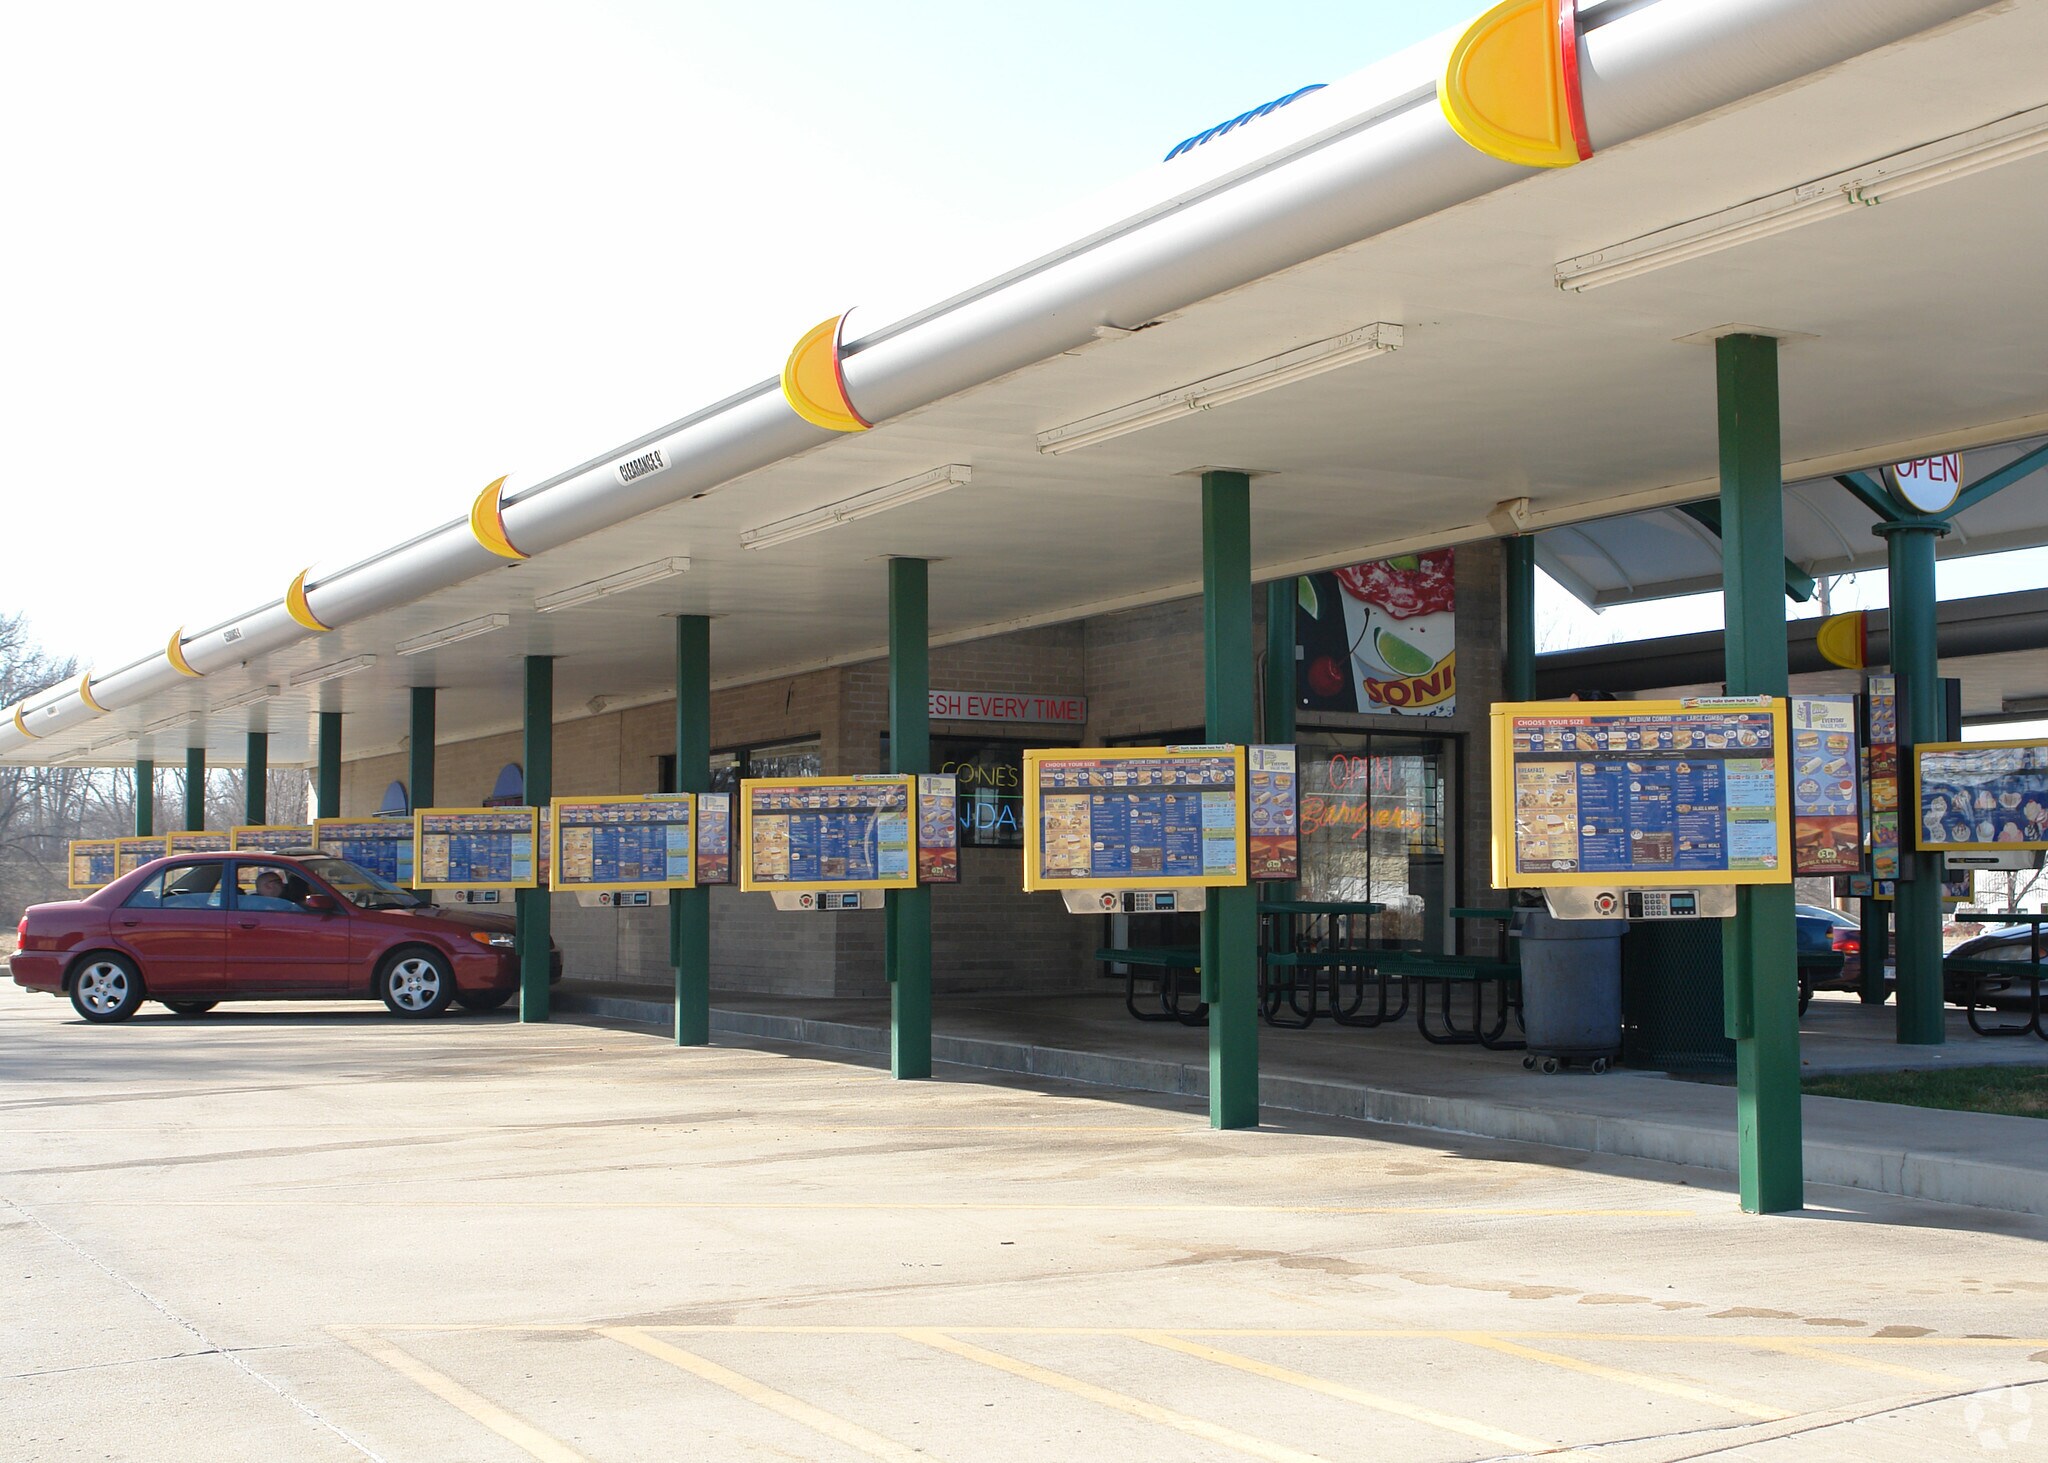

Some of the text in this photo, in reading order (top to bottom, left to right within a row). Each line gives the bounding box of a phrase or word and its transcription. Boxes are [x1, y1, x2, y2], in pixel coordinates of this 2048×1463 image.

[619, 453, 659, 482] CLEARANCE
[1363, 664, 1456, 706] SONI
[967, 696, 1031, 718] EVERY
[1033, 699, 1084, 720] TIME!
